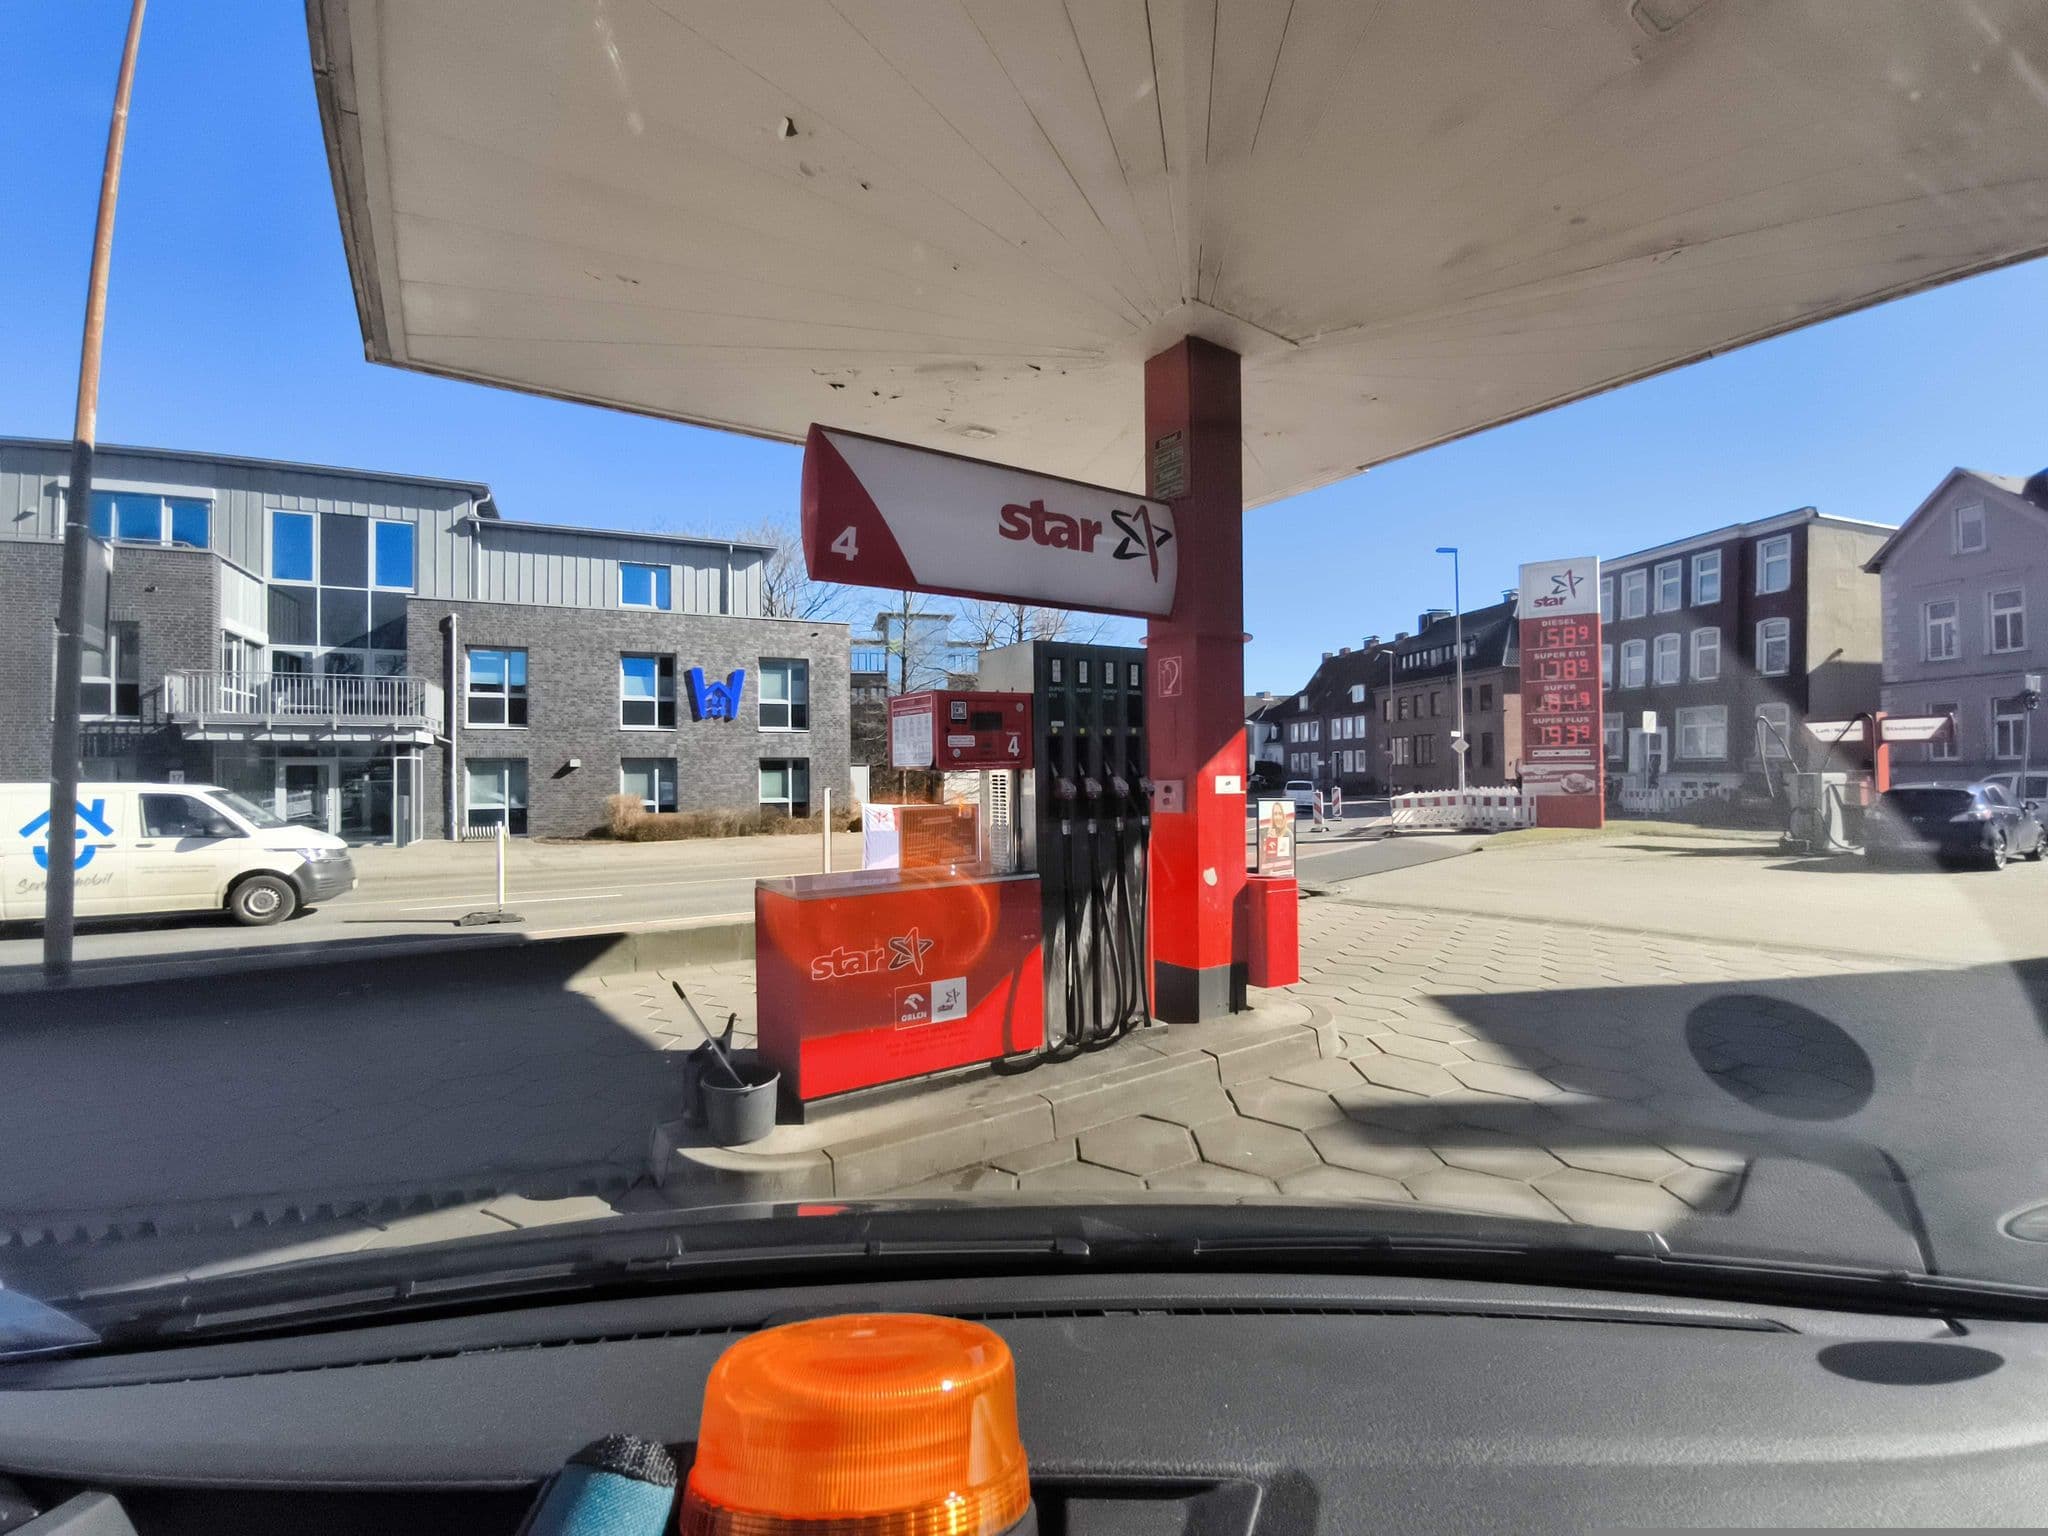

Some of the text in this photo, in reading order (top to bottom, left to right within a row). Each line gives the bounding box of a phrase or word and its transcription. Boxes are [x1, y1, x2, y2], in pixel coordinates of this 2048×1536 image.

[999, 500, 1102, 552] star
[831, 526, 859, 561] 4
[1533, 596, 1567, 608] star
[1541, 618, 1577, 627] DIESEL
[1534, 650, 1587, 660] SUPER E10
[1533, 716, 1590, 725] SUPER PLUS
[1007, 736, 1020, 757] 4
[811, 946, 885, 981] star
[901, 1011, 928, 1022] ORLEN
